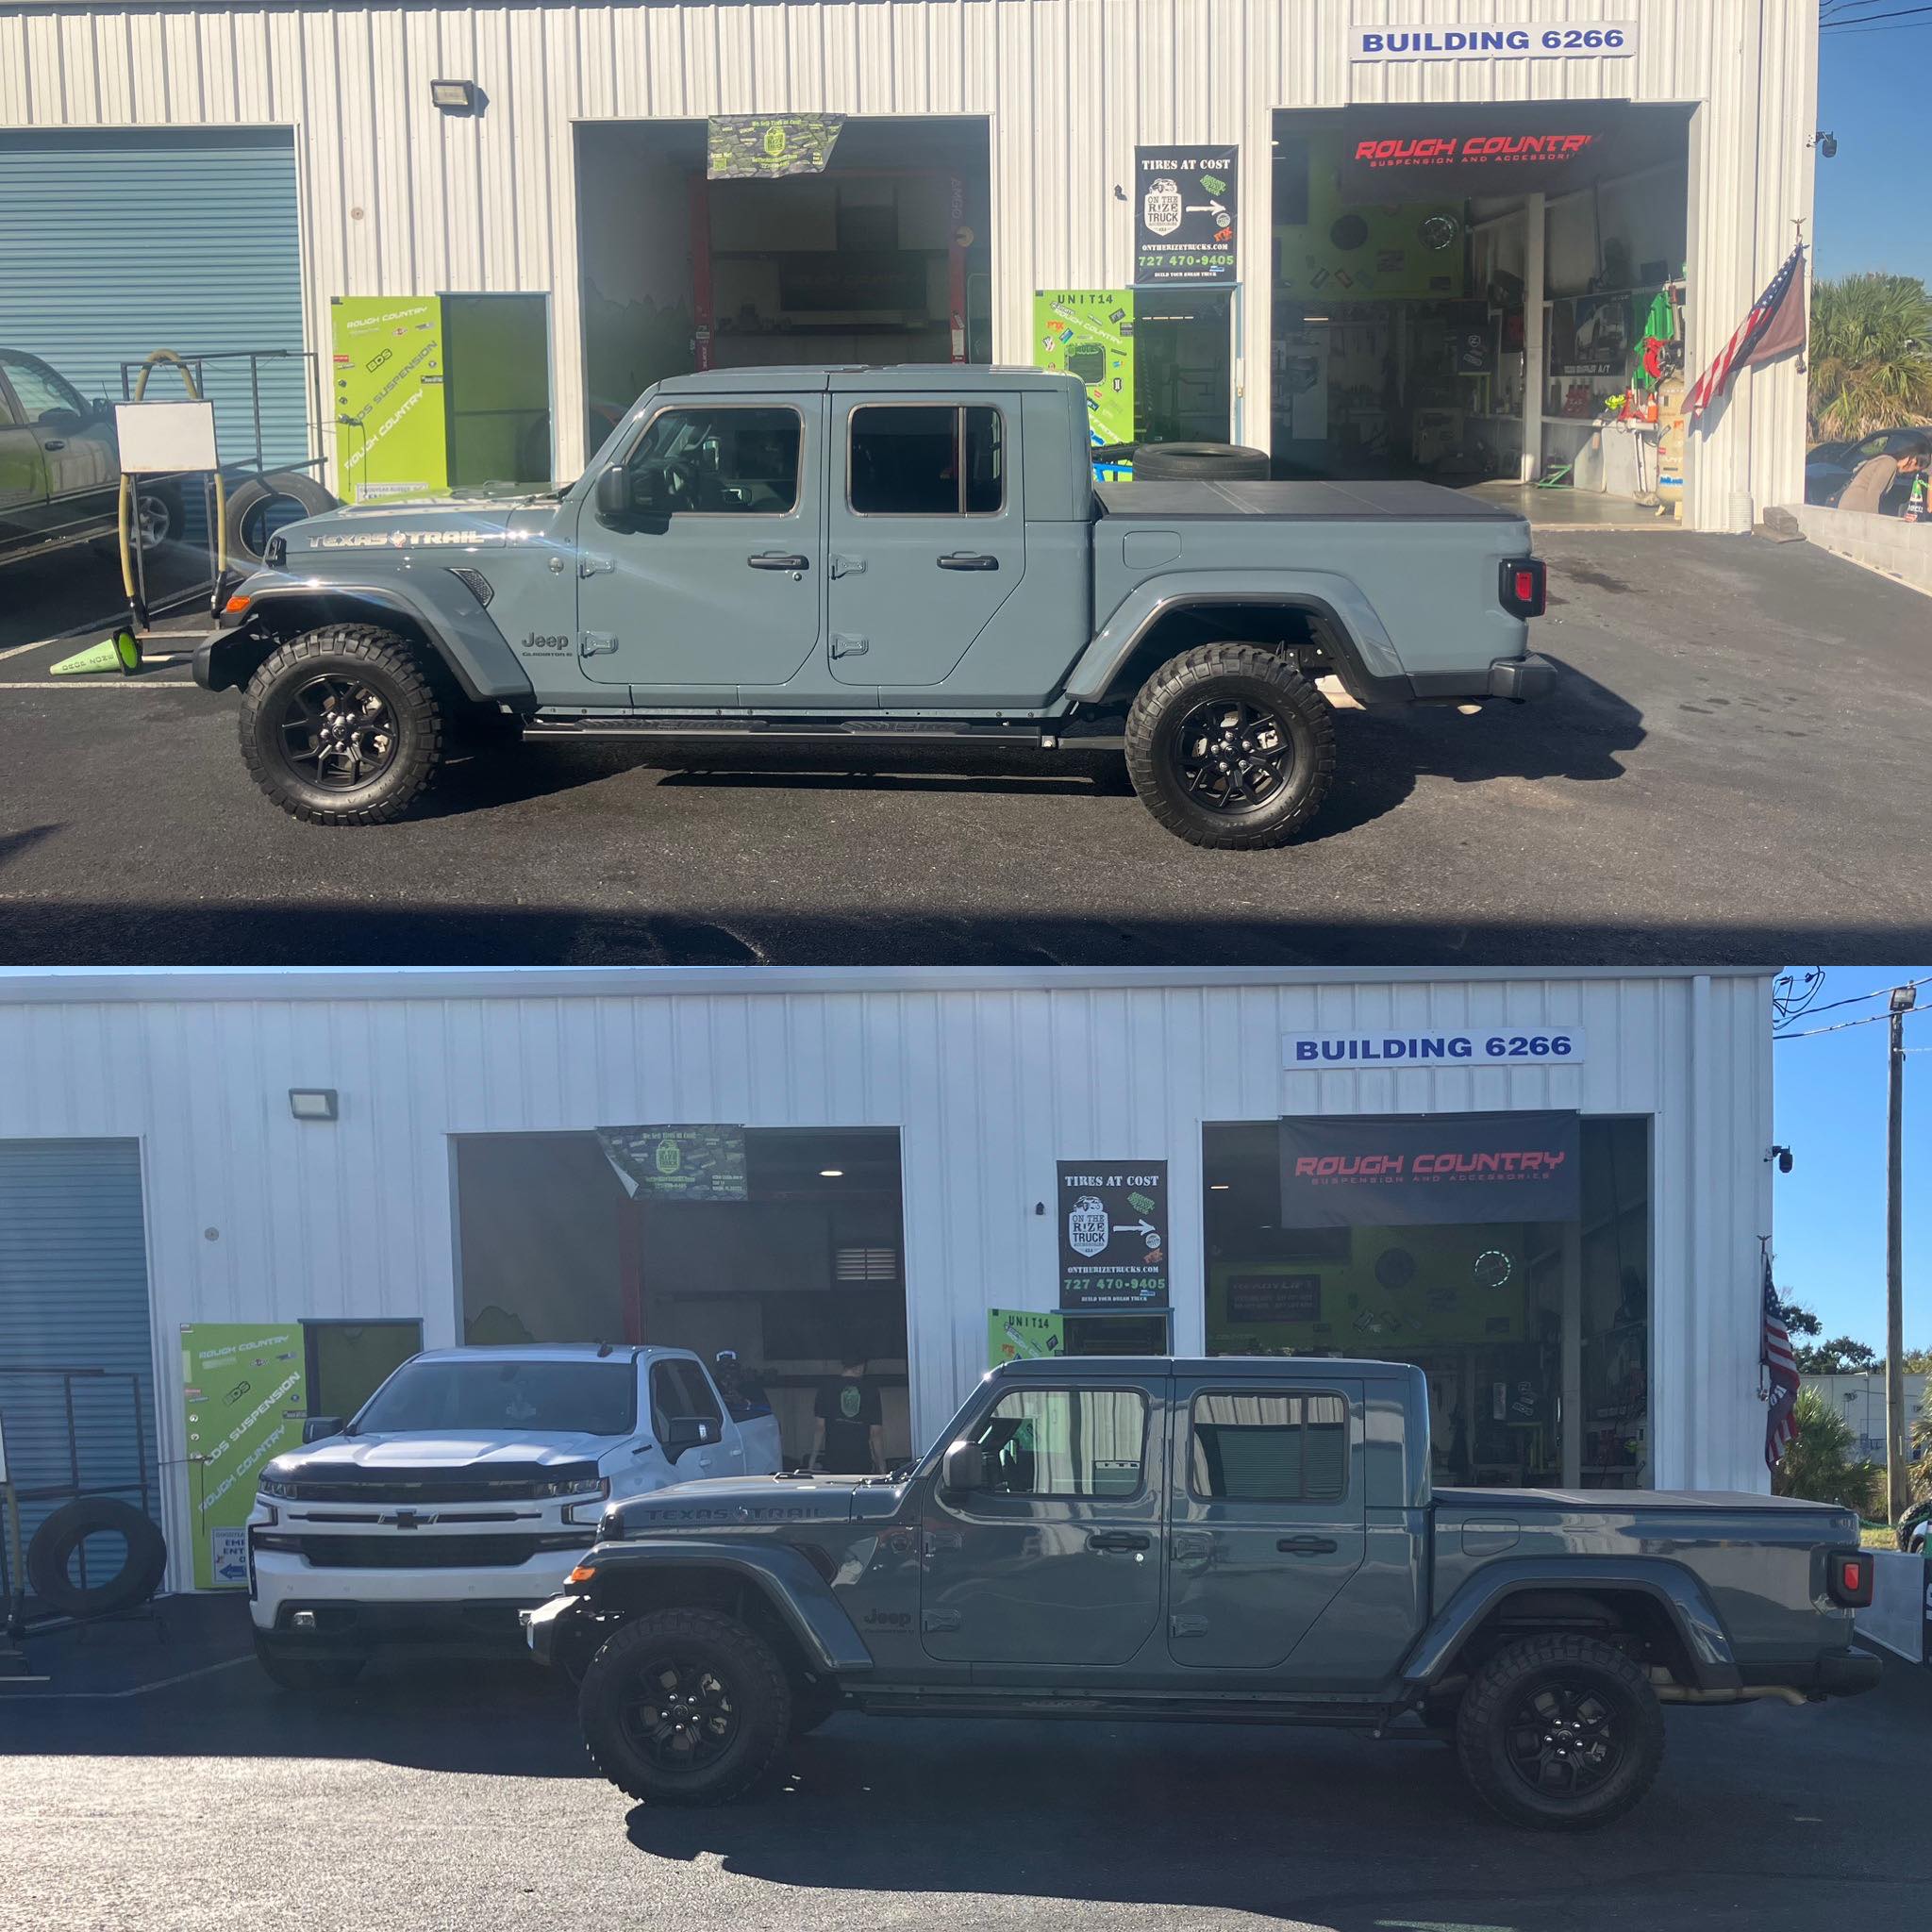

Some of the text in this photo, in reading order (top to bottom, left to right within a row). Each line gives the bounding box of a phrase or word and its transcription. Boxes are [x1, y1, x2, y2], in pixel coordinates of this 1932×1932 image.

[1362, 29, 1624, 53] BUILDING 6266
[1355, 135, 1592, 160] ROUGH COUNTR
[1141, 158, 1231, 170] TIRES AT COST
[1370, 158, 1454, 168] SUSPENSION
[1495, 152, 1575, 161] ACCESSORI
[1147, 212, 1178, 223] TRUCK
[1138, 255, 1234, 266] 727 470-9405
[346, 307, 427, 329] ROUGH COUNTRY
[366, 348, 392, 374] BDS
[374, 341, 438, 404] SUSPENSION
[344, 435, 379, 471] ROUGH
[378, 389, 425, 437] COUNTRY
[308, 530, 485, 548] TEXAS TRAIL
[521, 631, 569, 651] Jeep
[1295, 1036, 1572, 1061] BUILDING 6266
[1295, 1151, 1565, 1176] ROUGH COUNTRY
[1065, 1175, 1159, 1187] TIRES AT COST
[1311, 1176, 1404, 1186] SUSPENSION
[1449, 1173, 1550, 1182] ACCESSORIES
[1072, 1214, 1105, 1223] ON THE
[1073, 1232, 1105, 1242] TRUCK
[1064, 1278, 1166, 1290] 727 470-9405
[238, 1335, 290, 1352] COUNTRY
[229, 1371, 301, 1441] SUSPENSION
[235, 1424, 285, 1478] COUNTRY
[648, 1507, 823, 1521] TEXAS TRAIL
[863, 1608, 912, 1626] Jeep
